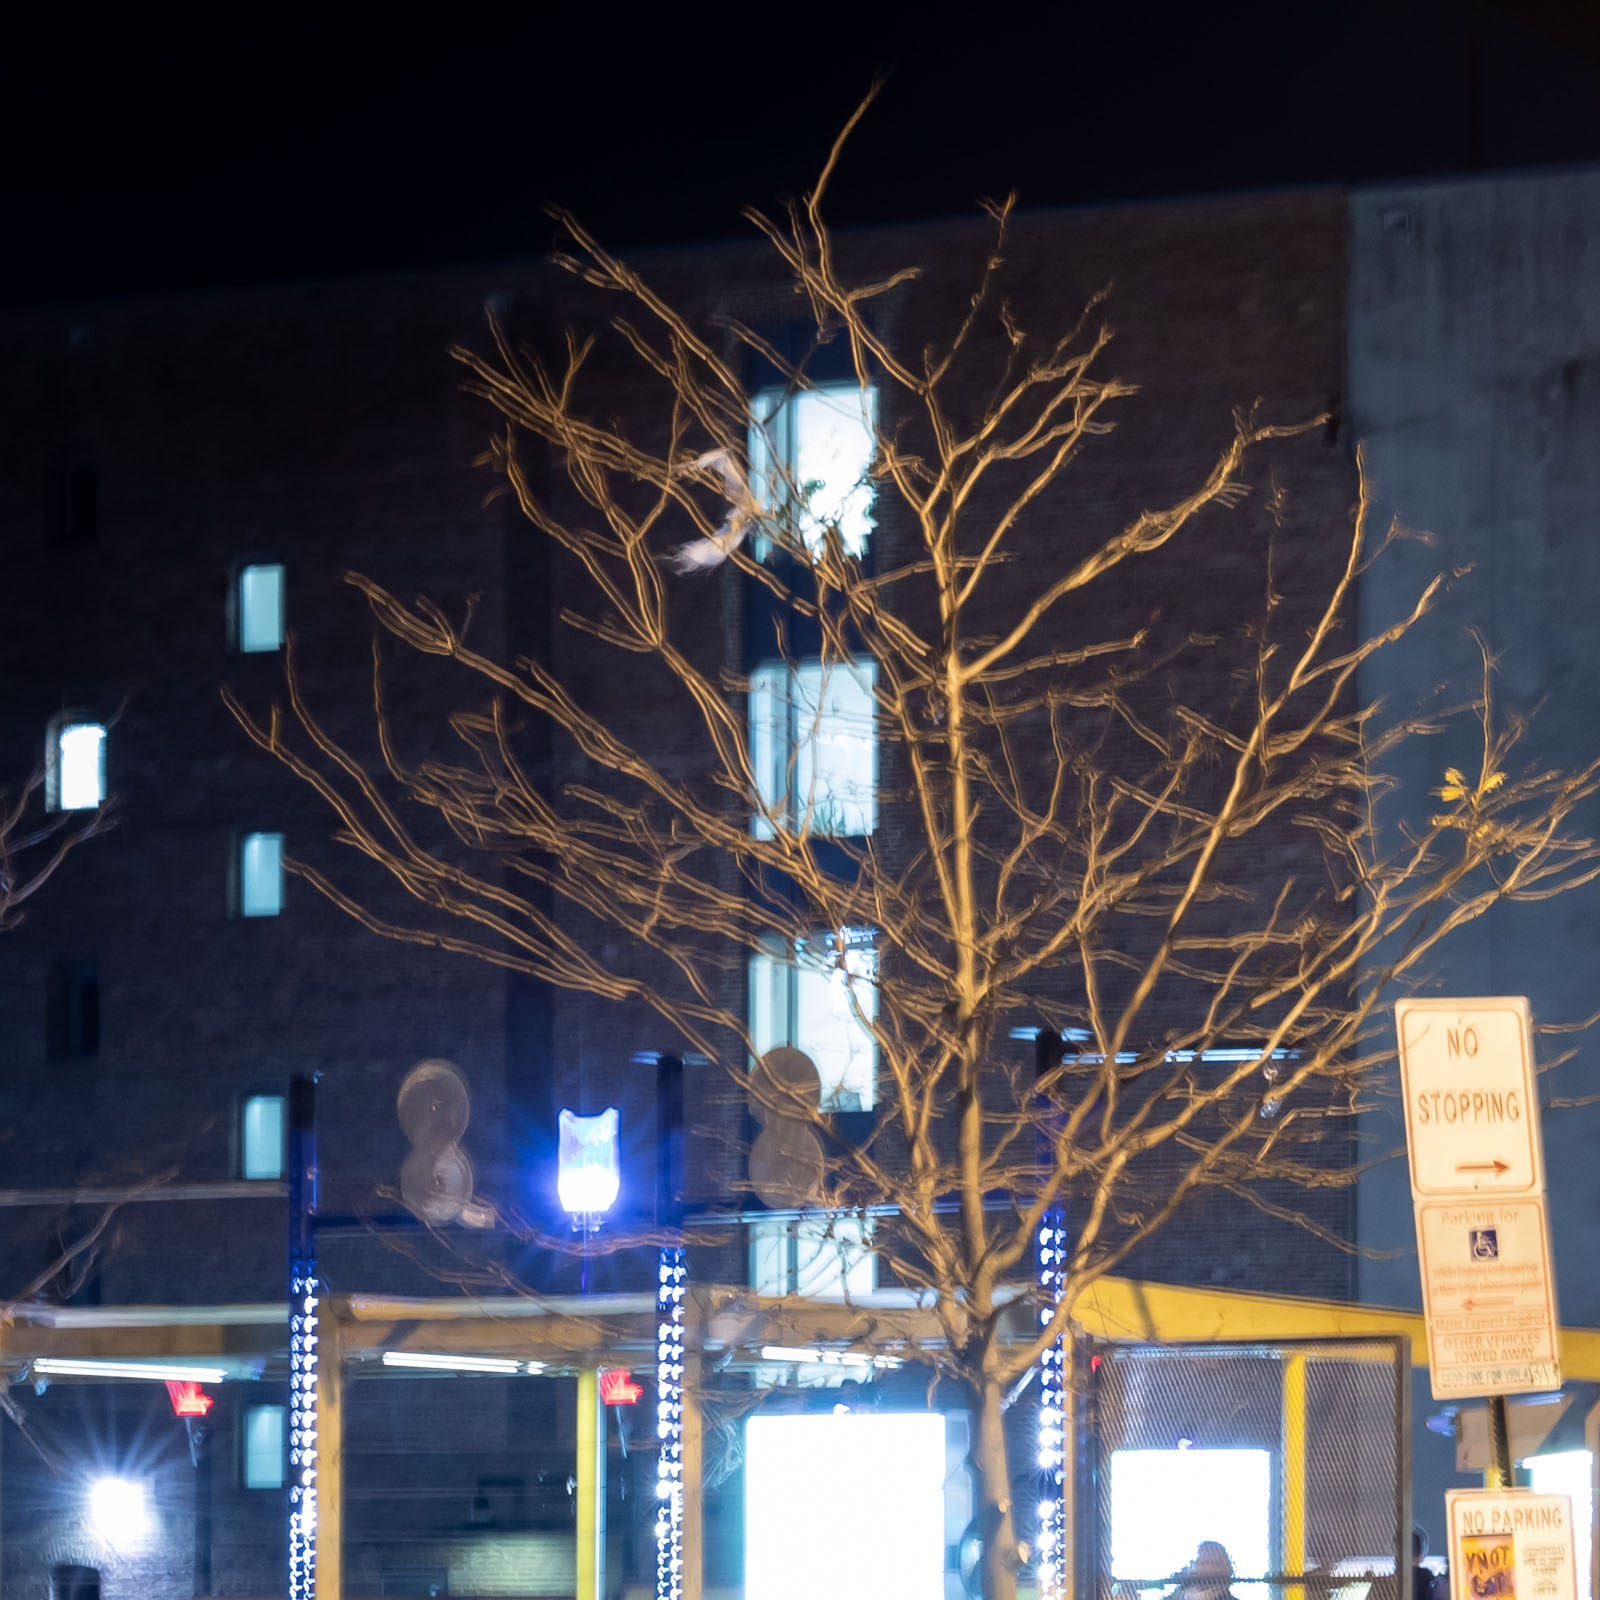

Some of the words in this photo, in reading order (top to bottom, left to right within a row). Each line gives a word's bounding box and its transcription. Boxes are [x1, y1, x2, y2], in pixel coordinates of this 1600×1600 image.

[1447, 1026, 1478, 1058] NO
[1418, 1091, 1520, 1124] STOPPING
[1441, 1209, 1494, 1228] Parking
[1499, 1208, 1519, 1224] for
[1443, 1334, 1486, 1349] OTHER
[1488, 1332, 1541, 1347] VEHICLES
[1454, 1350, 1499, 1363] TOWED
[1501, 1347, 1535, 1361] AWAY
[1463, 1510, 1485, 1533] NO
[1491, 1507, 1563, 1533] PARKING
